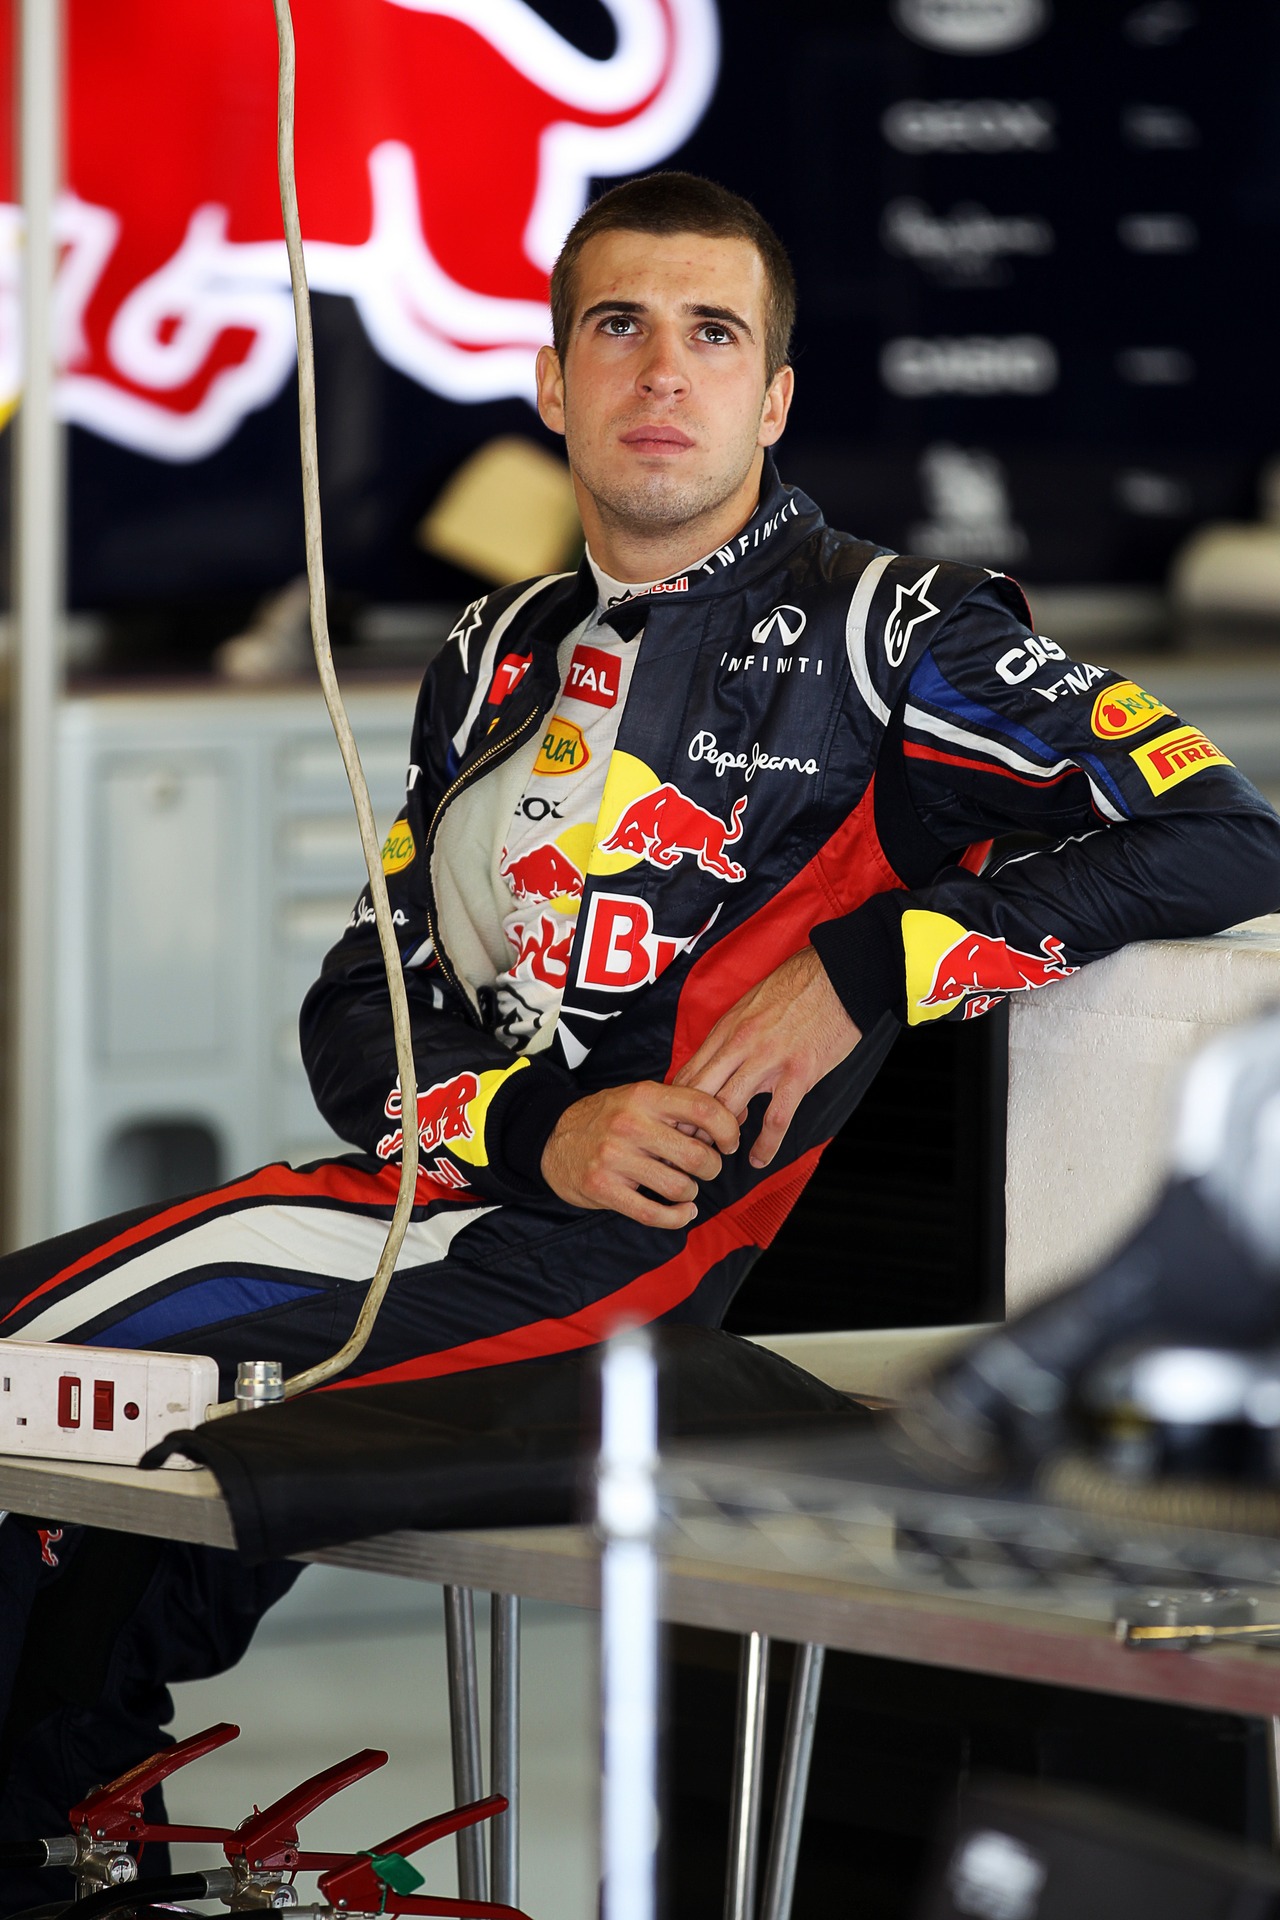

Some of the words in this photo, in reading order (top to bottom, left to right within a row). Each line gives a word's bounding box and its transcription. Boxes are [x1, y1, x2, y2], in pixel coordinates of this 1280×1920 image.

[720, 651, 823, 676] INFINITI
[688, 730, 748, 777] Pepe
[744, 742, 820, 782] Jeans
